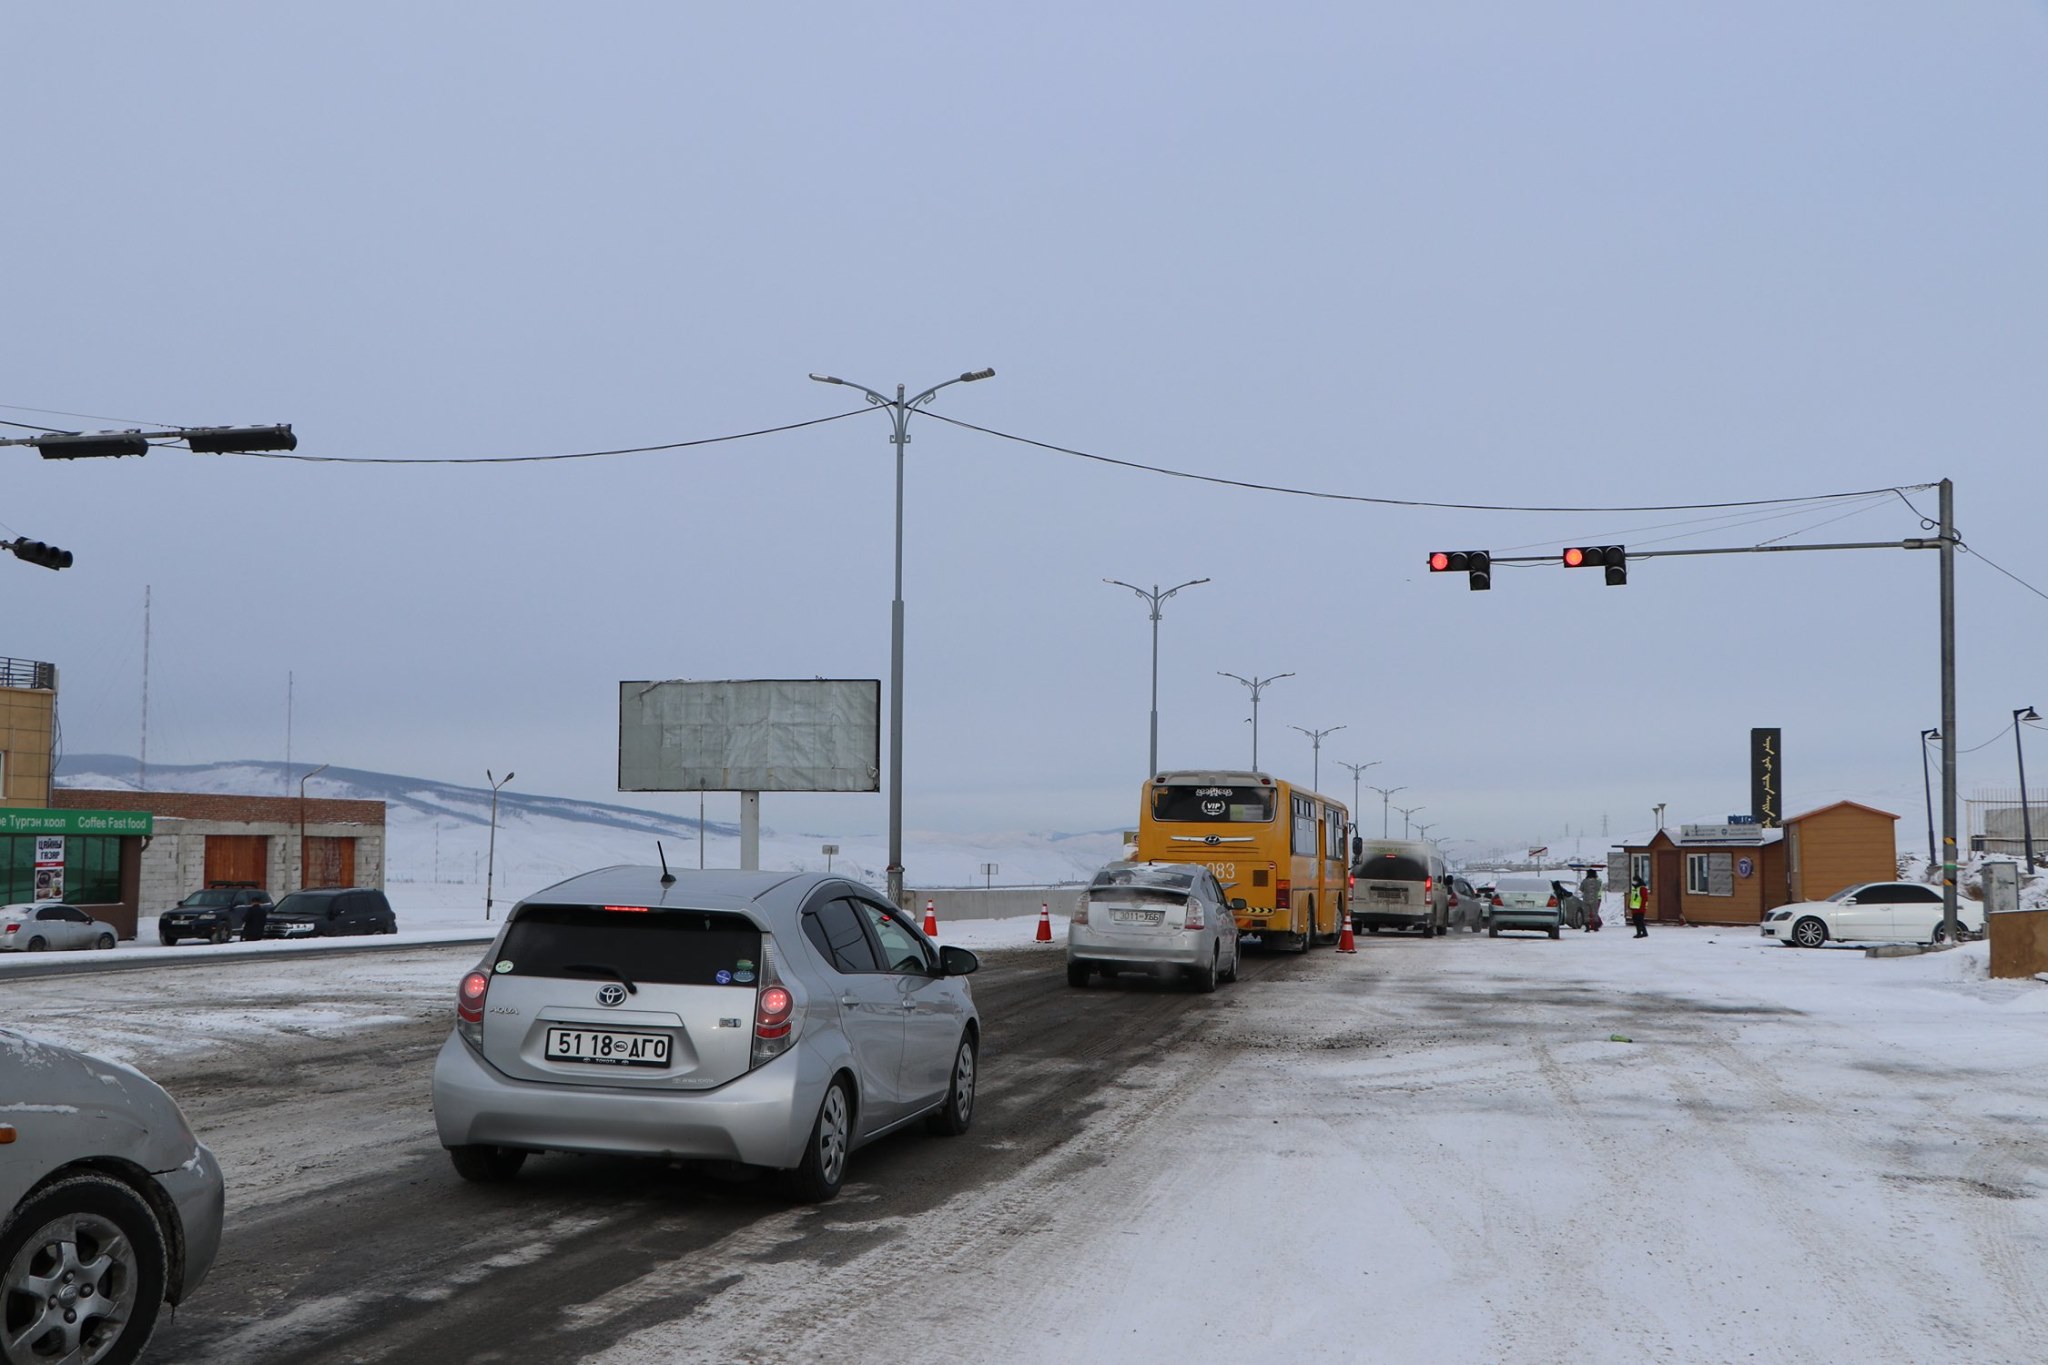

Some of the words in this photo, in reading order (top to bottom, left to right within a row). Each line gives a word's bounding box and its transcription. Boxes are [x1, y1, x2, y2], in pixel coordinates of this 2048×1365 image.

[1207, 802, 1221, 810] VIP
[9, 815, 42, 829] Түргэн
[44, 817, 66, 827] хоол
[78, 816, 107, 829] Coffee
[108, 817, 126, 829] Fast
[128, 817, 147, 829] food
[629, 1038, 666, 1058] ДГО
